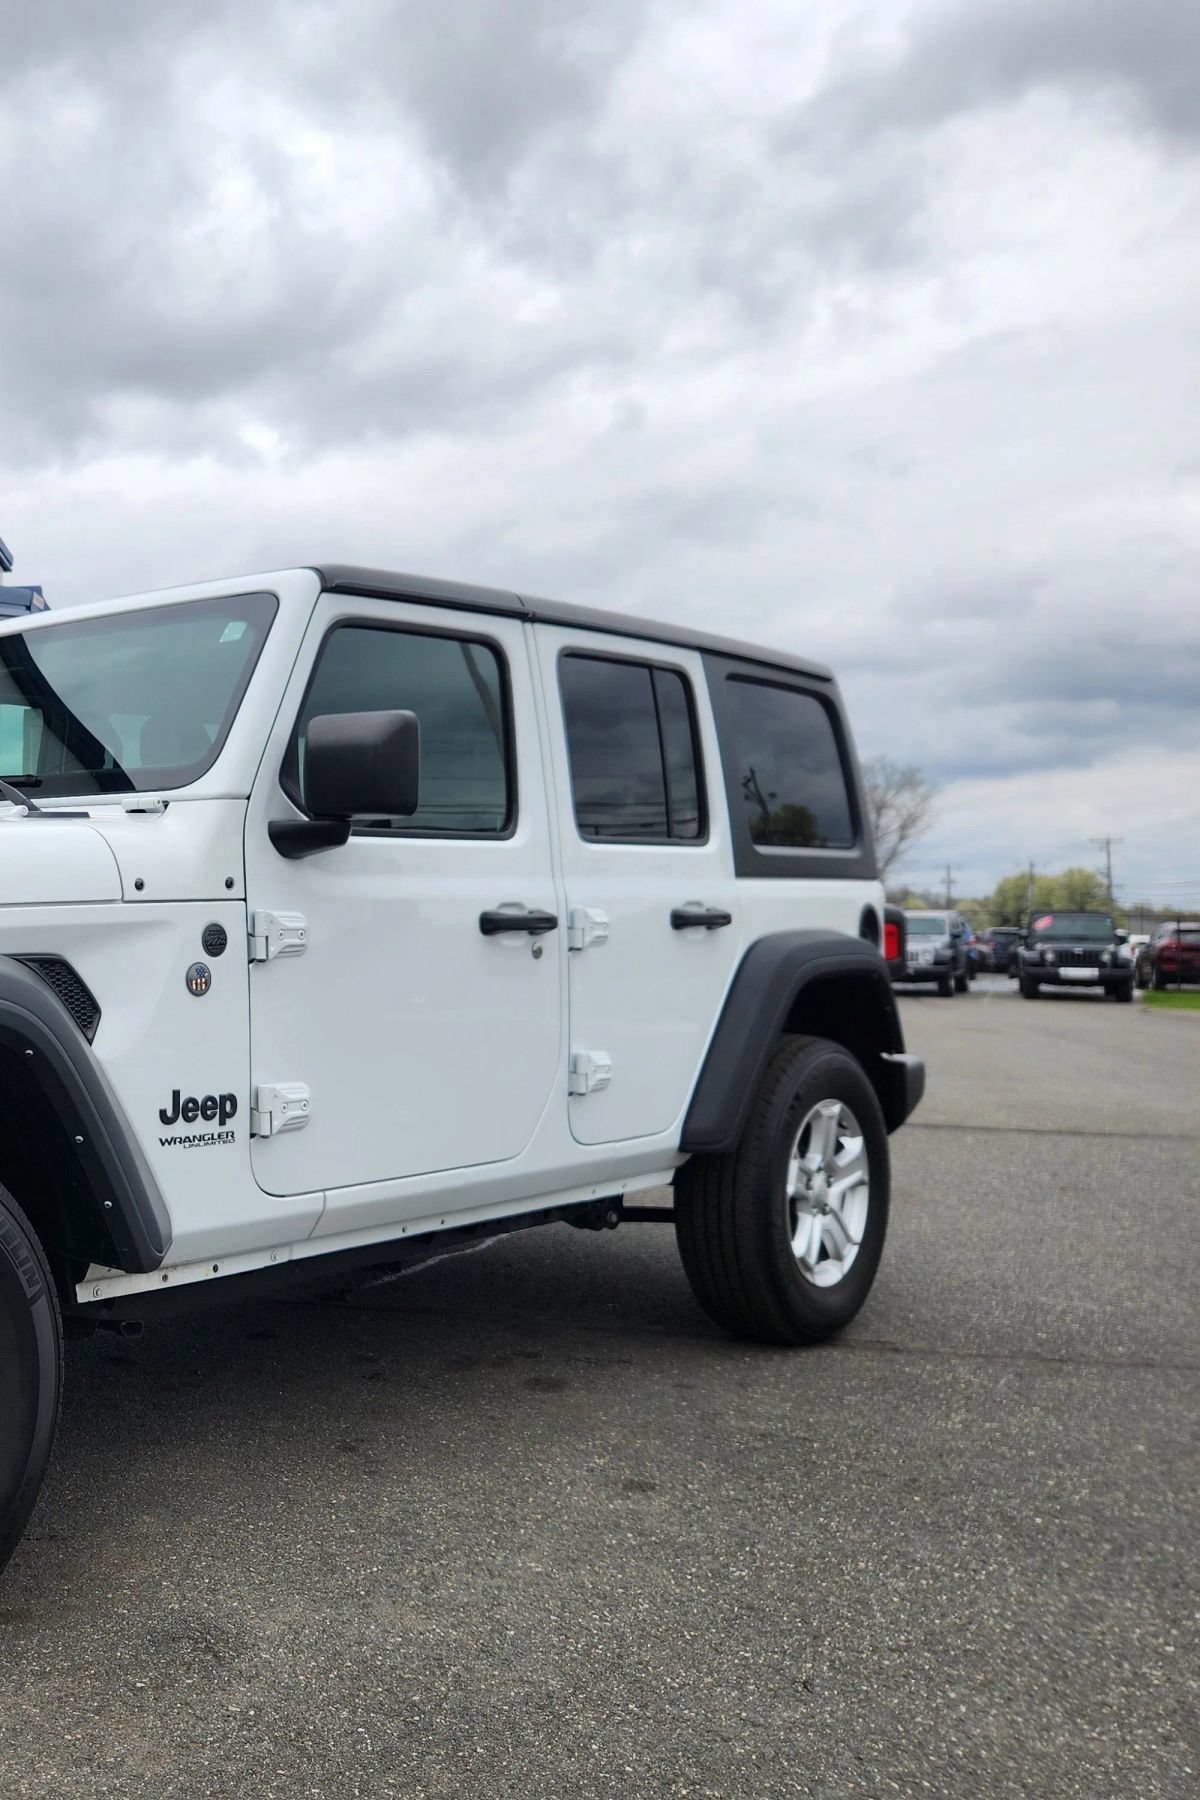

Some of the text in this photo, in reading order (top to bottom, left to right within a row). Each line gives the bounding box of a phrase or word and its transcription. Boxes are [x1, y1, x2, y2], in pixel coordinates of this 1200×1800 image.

[159, 1089, 238, 1126] Jeep
[158, 1130, 236, 1148] WRANGLER
[183, 1138, 236, 1149] UNLIMITED
